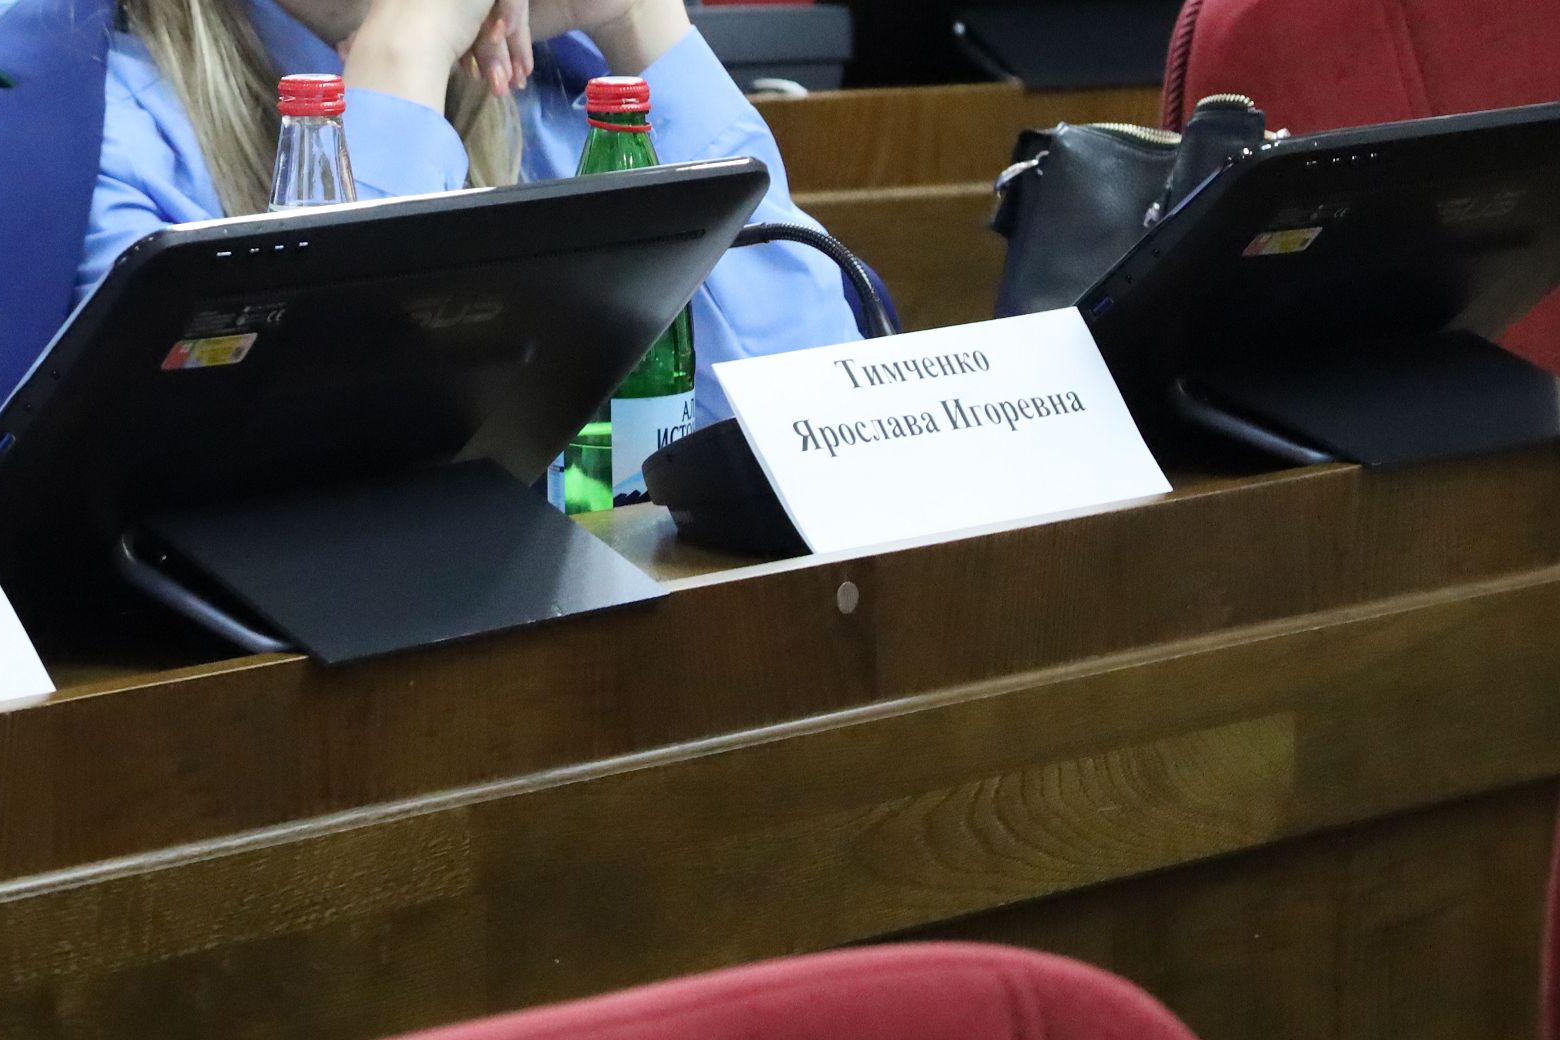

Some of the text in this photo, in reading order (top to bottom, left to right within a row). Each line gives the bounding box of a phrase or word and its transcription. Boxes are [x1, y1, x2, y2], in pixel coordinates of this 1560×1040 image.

[834, 348, 990, 389] Тимченко
[681, 398, 696, 422] АЛ
[792, 390, 1086, 458] Ярослава Игоревна
[657, 421, 696, 451] ИСТО
